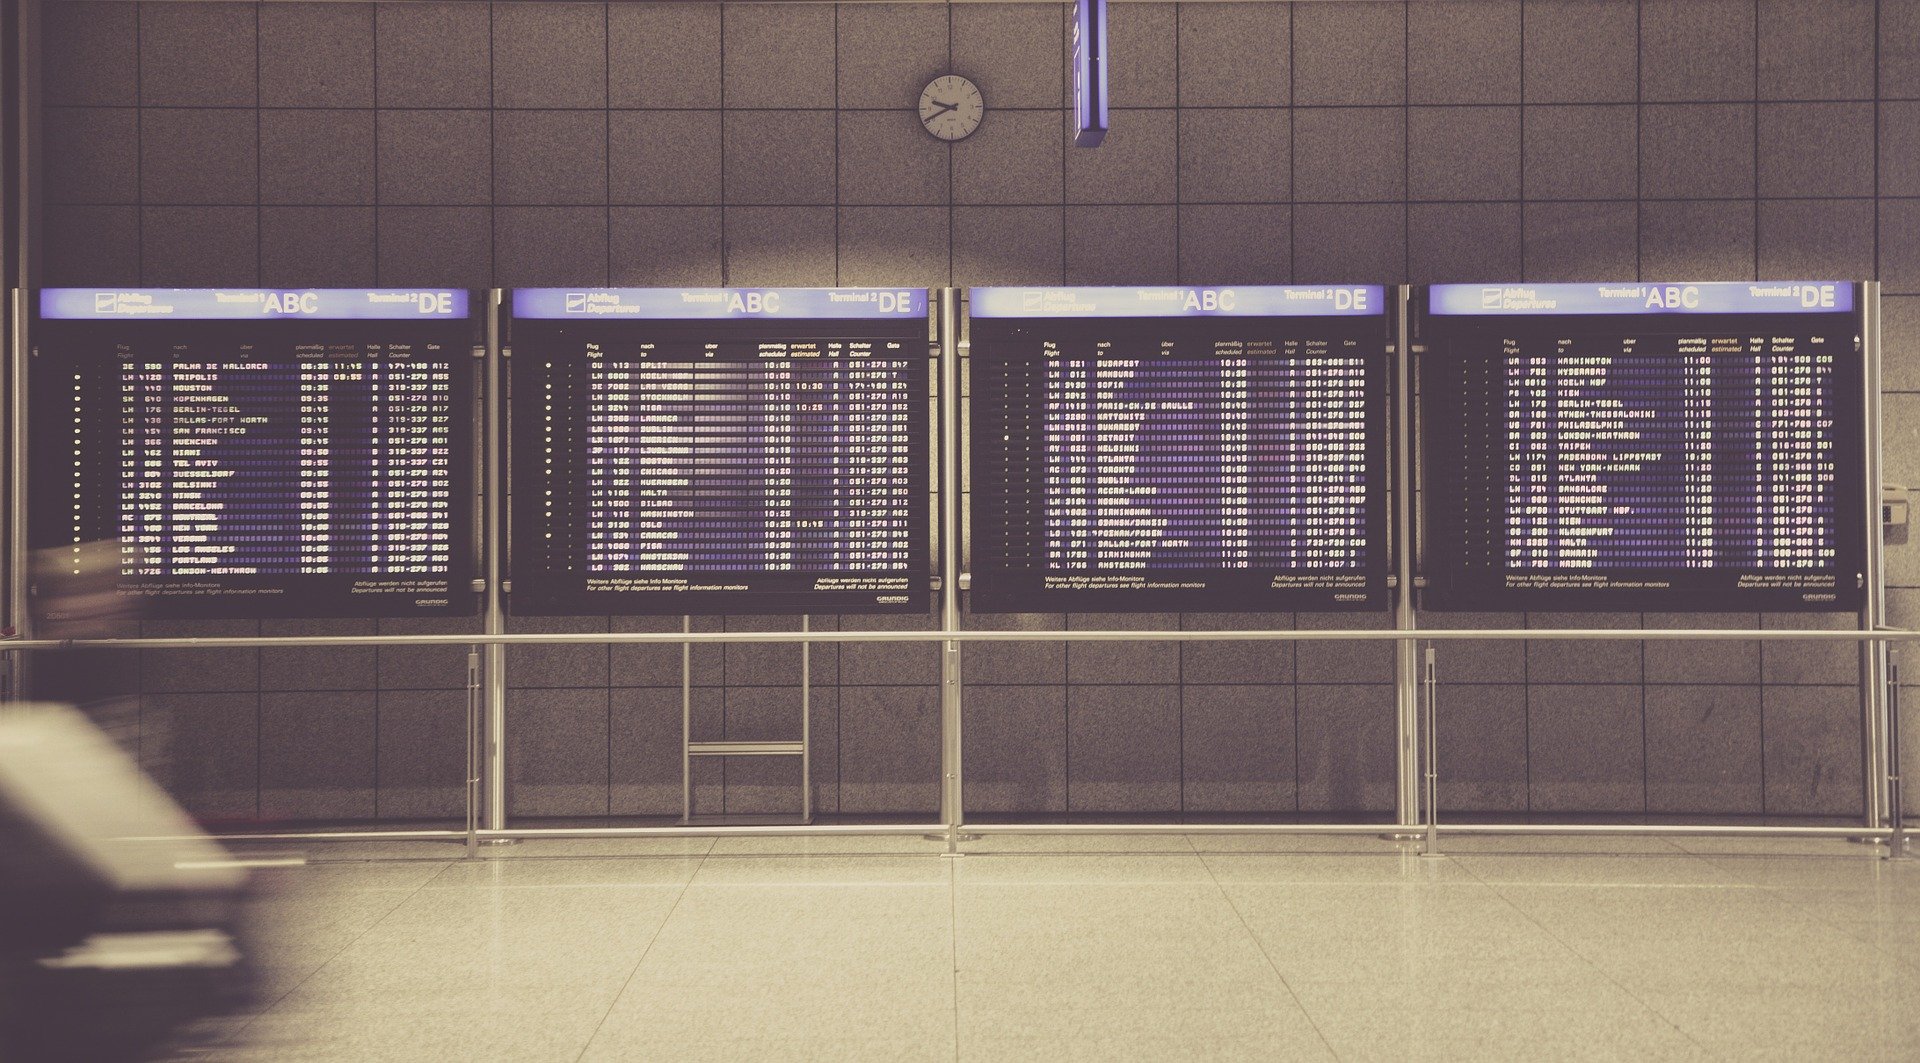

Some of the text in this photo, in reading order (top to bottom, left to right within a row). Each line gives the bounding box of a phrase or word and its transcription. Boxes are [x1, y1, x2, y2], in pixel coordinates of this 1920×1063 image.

[215, 293, 258, 303] Terminal
[264, 293, 318, 314] ABC
[367, 293, 452, 313] Terminal 2 DE
[681, 293, 723, 302] Terminal
[727, 292, 780, 313] ABC
[829, 292, 911, 312] Terminal 2 DE
[1138, 291, 1177, 301] Terminal
[1183, 290, 1236, 311] ABC
[1285, 289, 1367, 310] Terminal 2 DE
[1599, 287, 1639, 298] Terminal
[1645, 286, 1699, 309] ABC
[1749, 285, 1835, 307] Terminal 2 DE
